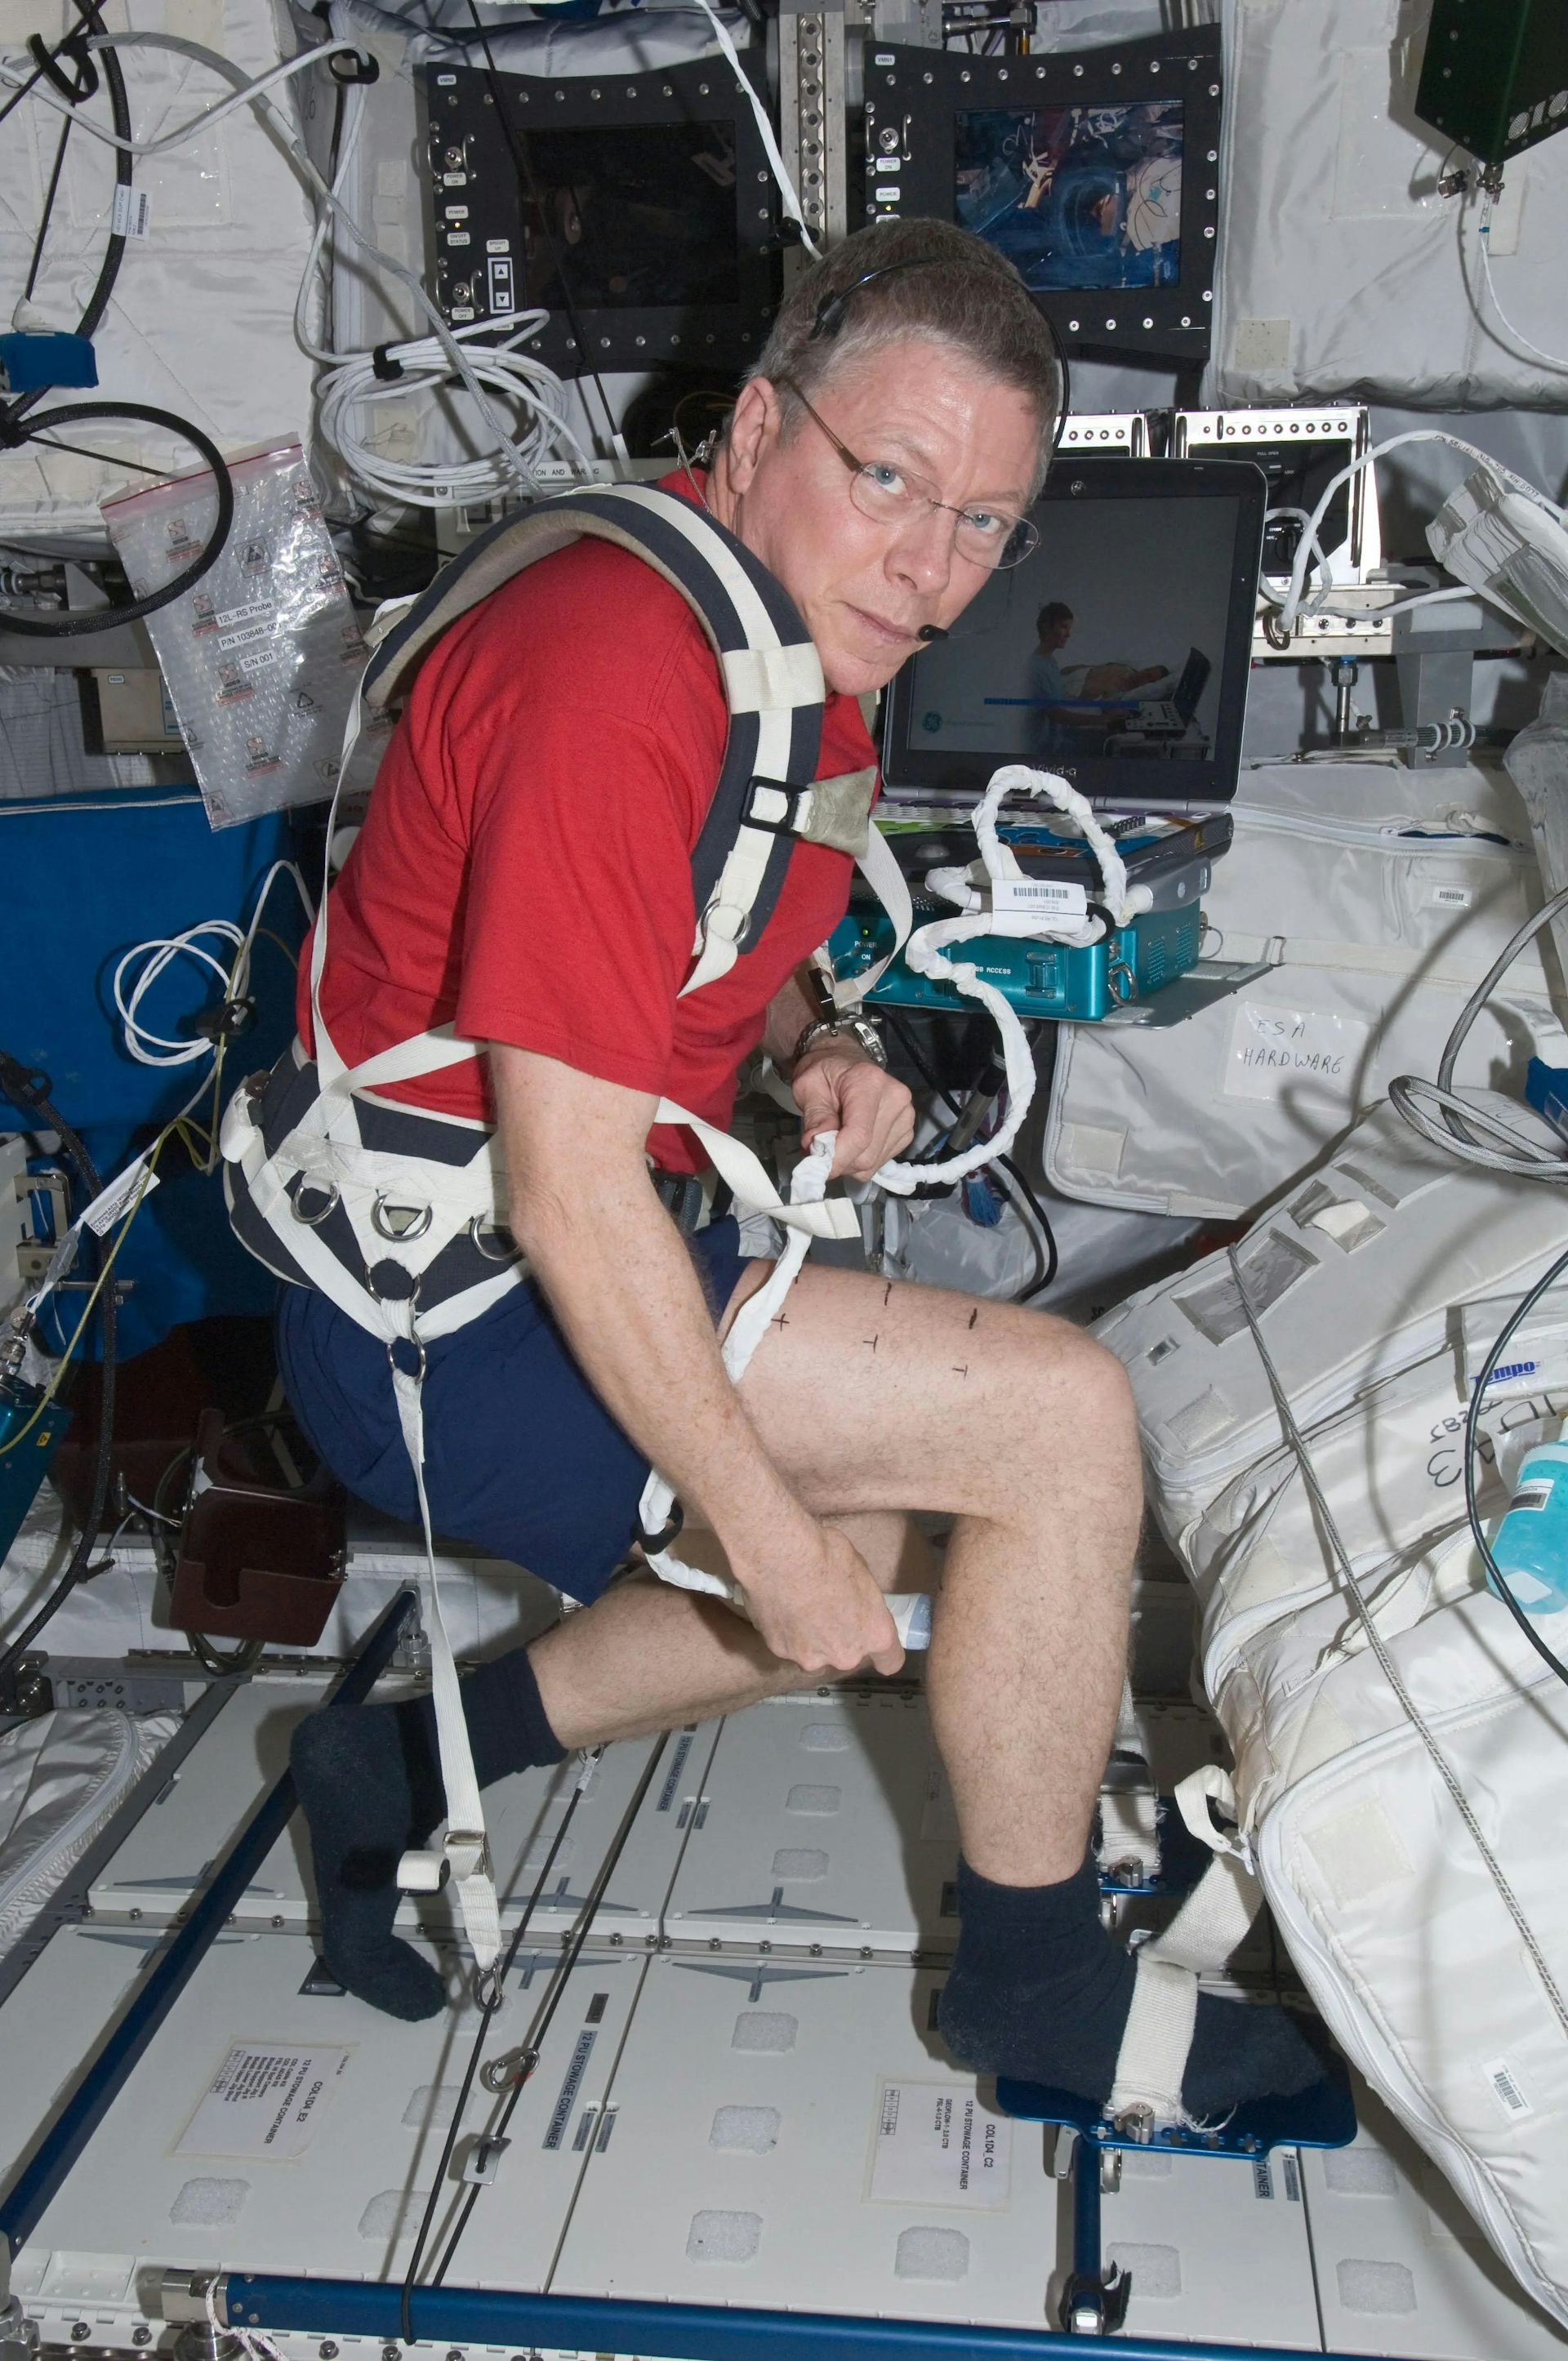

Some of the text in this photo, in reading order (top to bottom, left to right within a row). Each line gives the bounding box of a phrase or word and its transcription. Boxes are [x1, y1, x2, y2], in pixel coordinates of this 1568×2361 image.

[219, 608, 248, 624] 12L-RS
[249, 601, 273, 614] Probe
[220, 636, 236, 648] P/N
[243, 653, 274, 669] S/N 001
[854, 941, 877, 949] POWER
[1256, 1019, 1307, 1039] ESA
[1243, 1047, 1345, 1075] HARDWARE
[1473, 1361, 1535, 1383] mpo
[659, 1779, 677, 1811] CONTAINER
[577, 2042, 590, 2053] PU
[582, 2032, 594, 2041] 12
[563, 2054, 586, 2096] STOWAGE
[281, 2076, 304, 2106] STOWAGE
[293, 2081, 323, 2122] COL1D4_E2
[262, 2107, 288, 2144] CONTAINER
[545, 2097, 572, 2149] CONTAINER
[964, 2109, 973, 2118] PU
[962, 2118, 972, 2150] STOWAGE
[983, 2124, 996, 2167] COL1D4_C2
[960, 2151, 969, 2189] CONTAINER
[1256, 2160, 1270, 2197] TAINER
